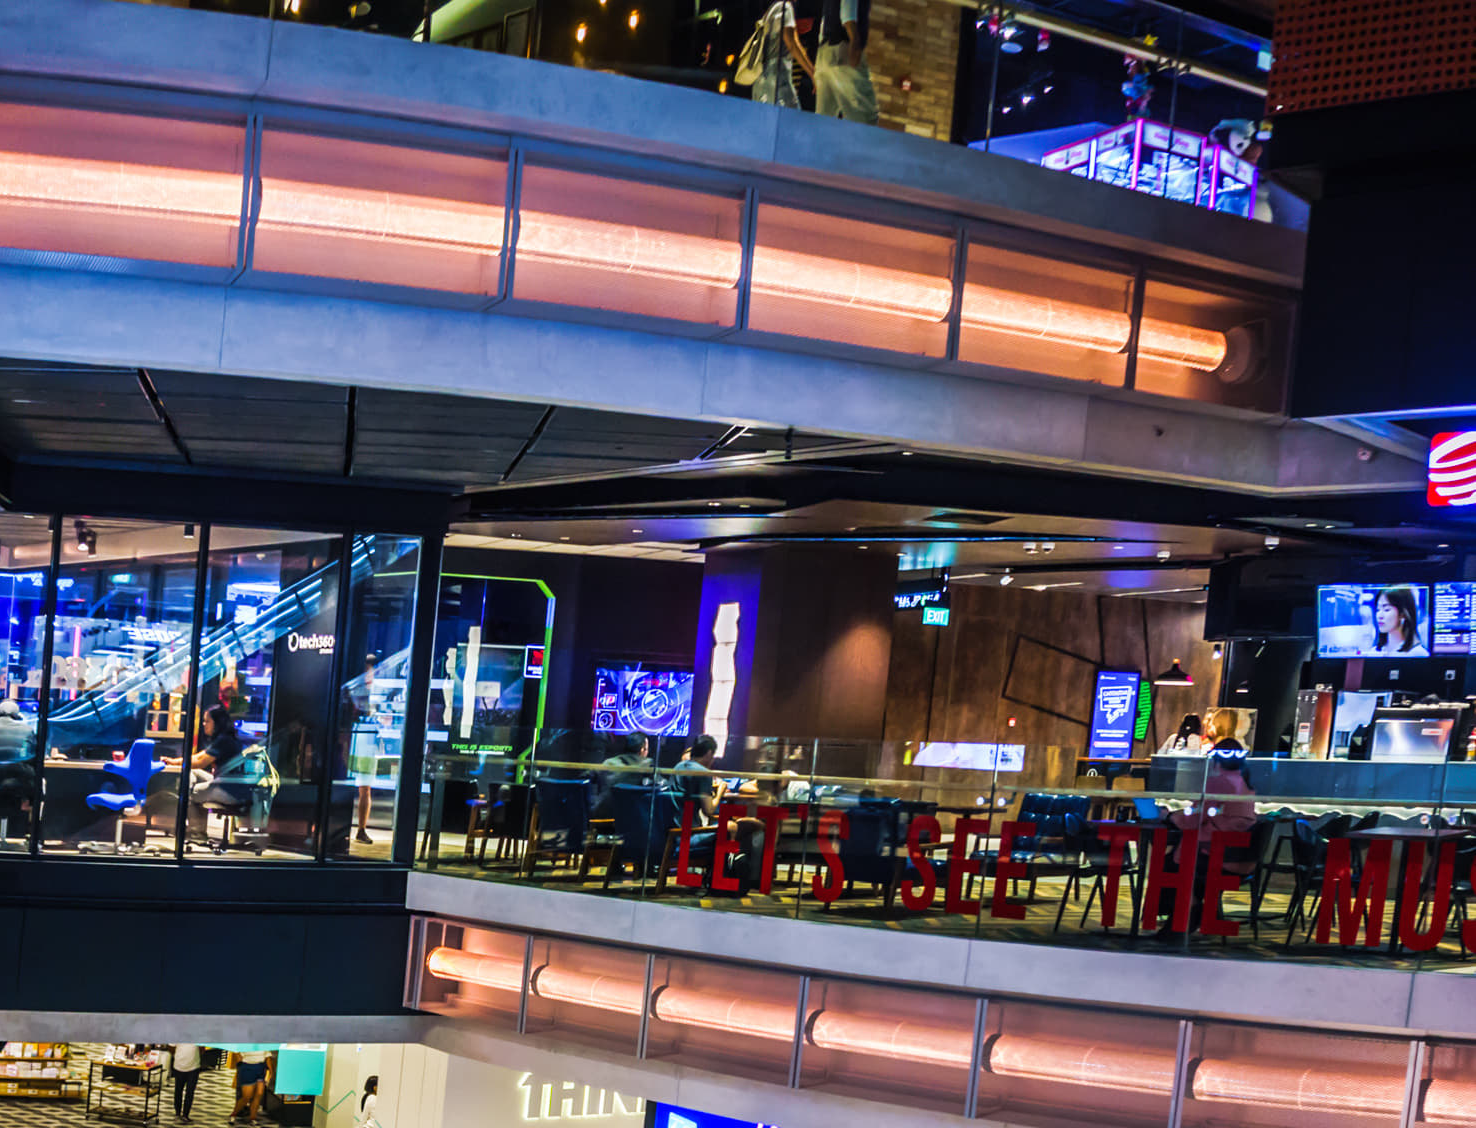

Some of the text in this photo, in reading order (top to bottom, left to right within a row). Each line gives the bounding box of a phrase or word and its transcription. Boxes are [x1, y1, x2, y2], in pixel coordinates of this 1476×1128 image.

[927, 610, 945, 623] EXIT
[298, 633, 335, 649] tech360
[676, 801, 850, 903] LET'S
[901, 815, 1037, 920] SEE
[1098, 825, 1253, 936] THE
